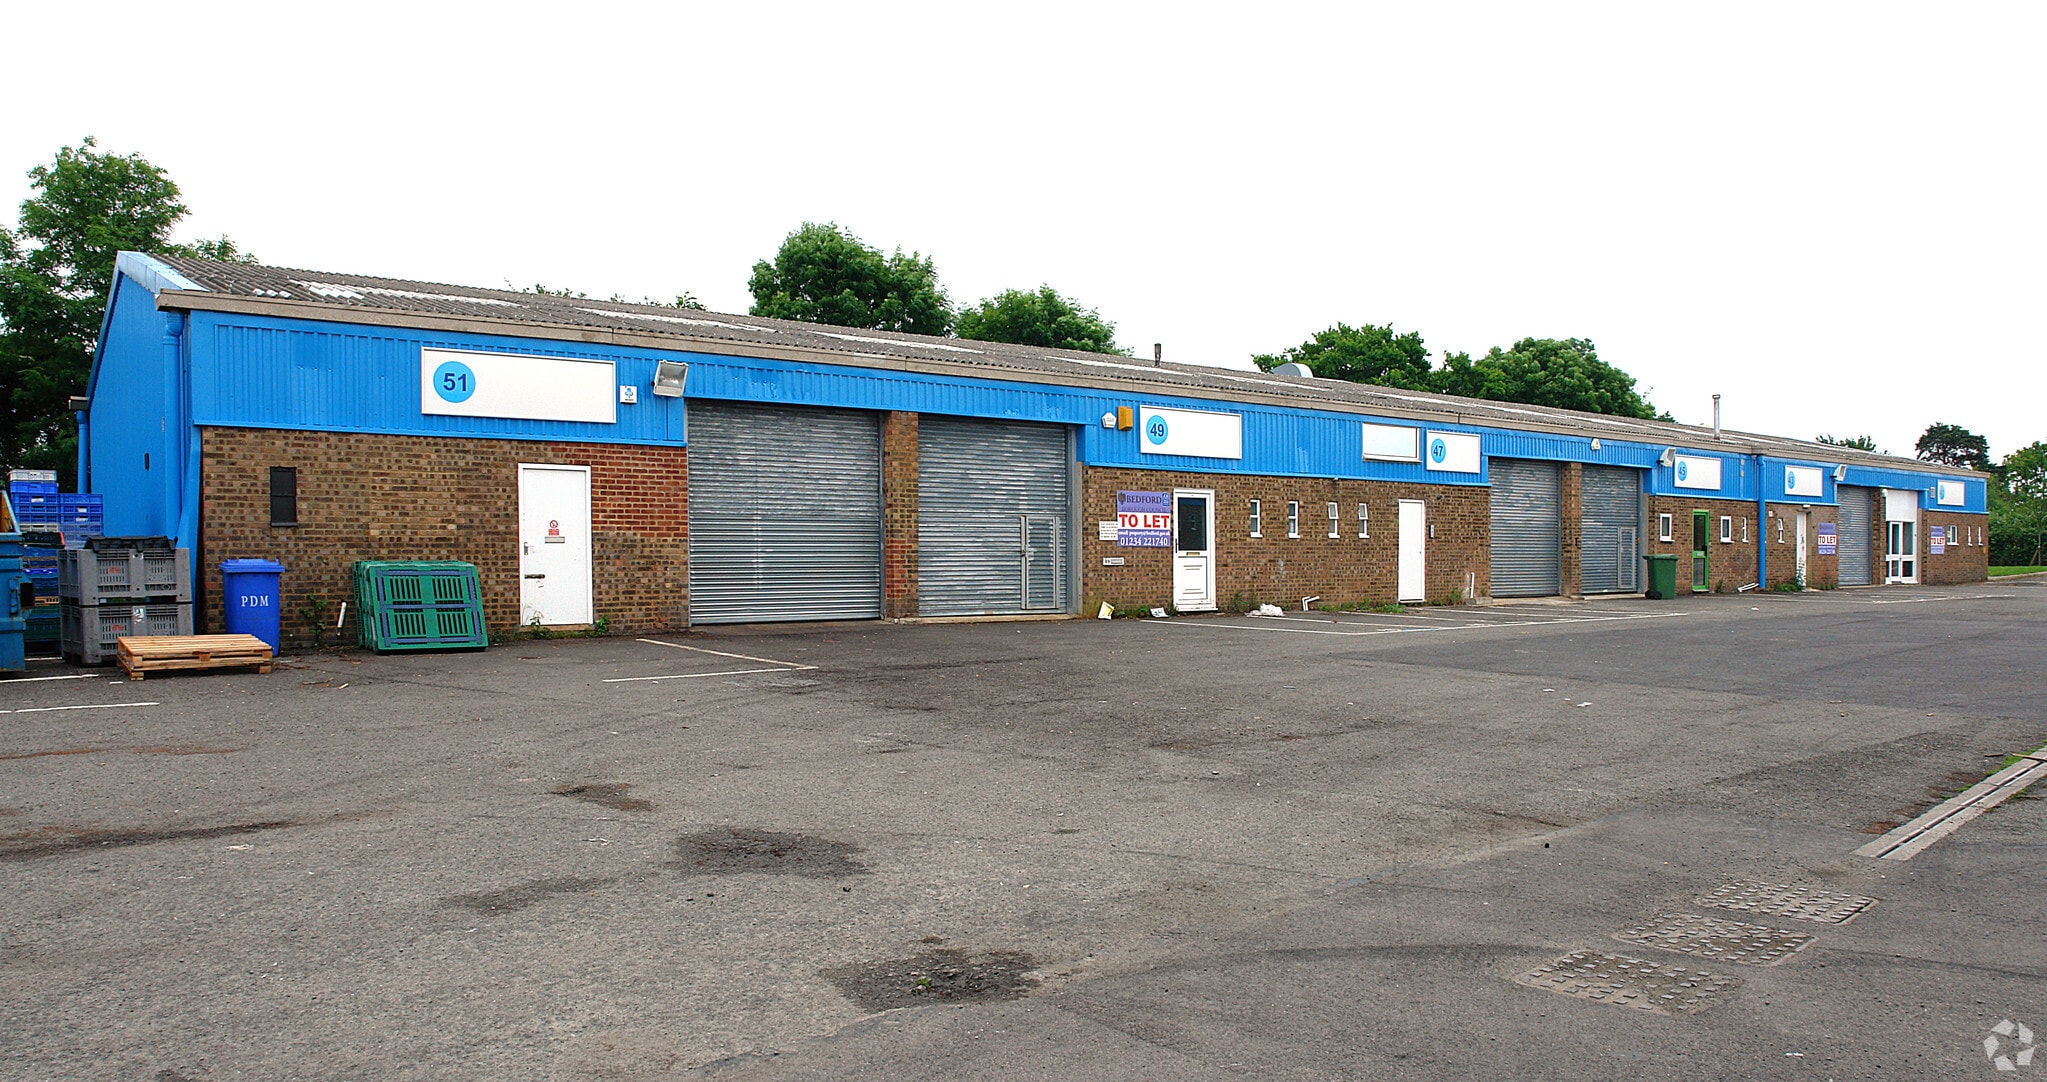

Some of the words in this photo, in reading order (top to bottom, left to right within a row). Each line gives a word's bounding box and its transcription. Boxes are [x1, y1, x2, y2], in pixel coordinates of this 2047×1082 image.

[443, 372, 467, 392] 51
[1150, 423, 1165, 437] 49
[1433, 445, 1443, 456] 47
[1678, 466, 1686, 476] 45
[1126, 495, 1162, 504] BEDFORD
[1118, 513, 1139, 528] TO
[1143, 514, 1170, 529] LET
[1120, 537, 1142, 546] 01234
[1143, 537, 1168, 546] 221740
[1819, 536, 1826, 544] TO
[1826, 536, 1836, 544] LET
[241, 595, 269, 607] PDM
